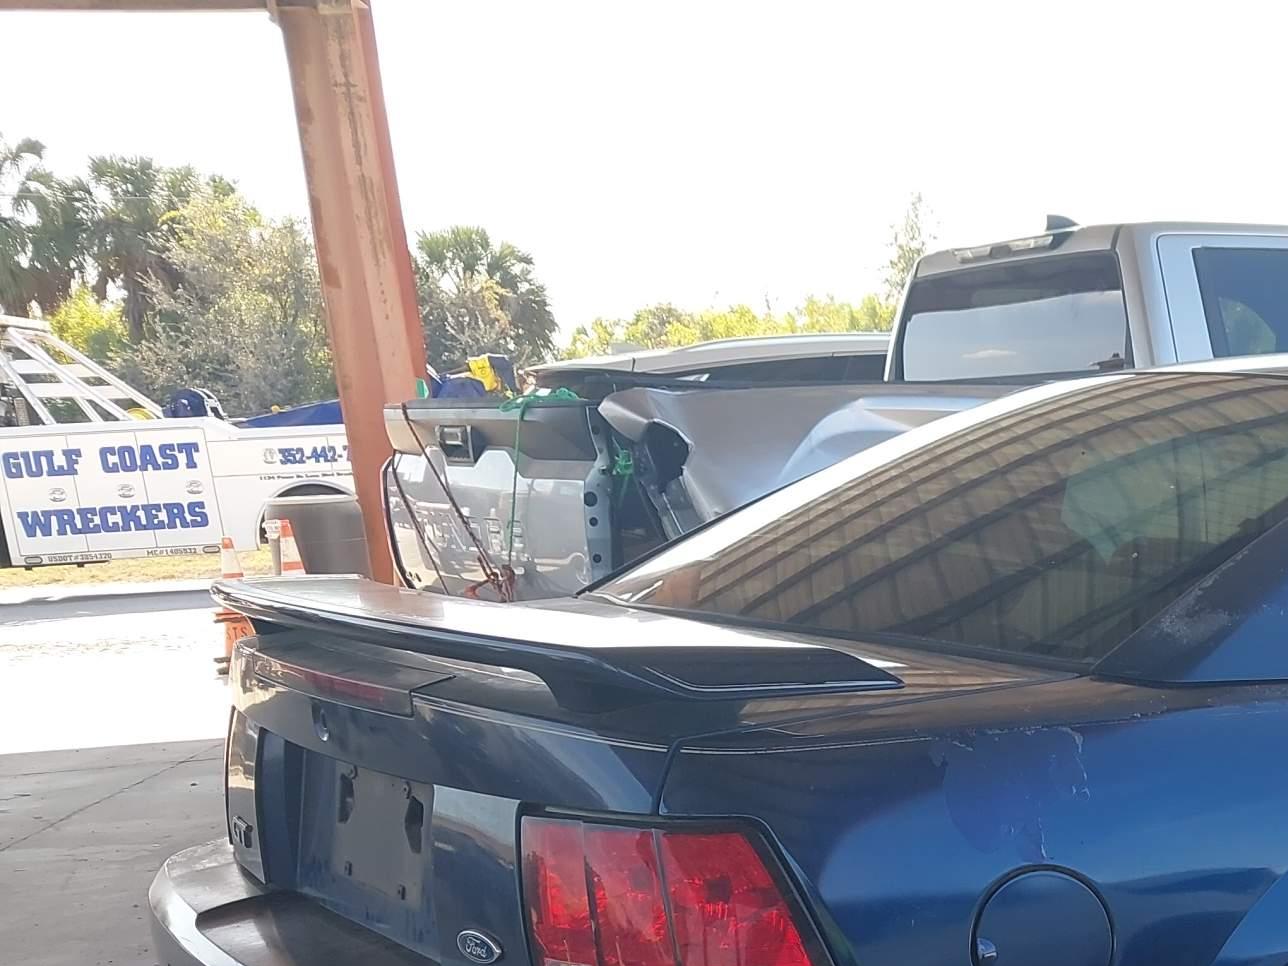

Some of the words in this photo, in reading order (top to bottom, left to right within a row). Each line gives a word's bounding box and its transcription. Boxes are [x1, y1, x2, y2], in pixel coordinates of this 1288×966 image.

[2, 449, 82, 479] GULF
[99, 442, 199, 474] COAST
[16, 501, 209, 537] WRECKERS
[232, 816, 253, 849] GT
[465, 936, 488, 959] Ford
